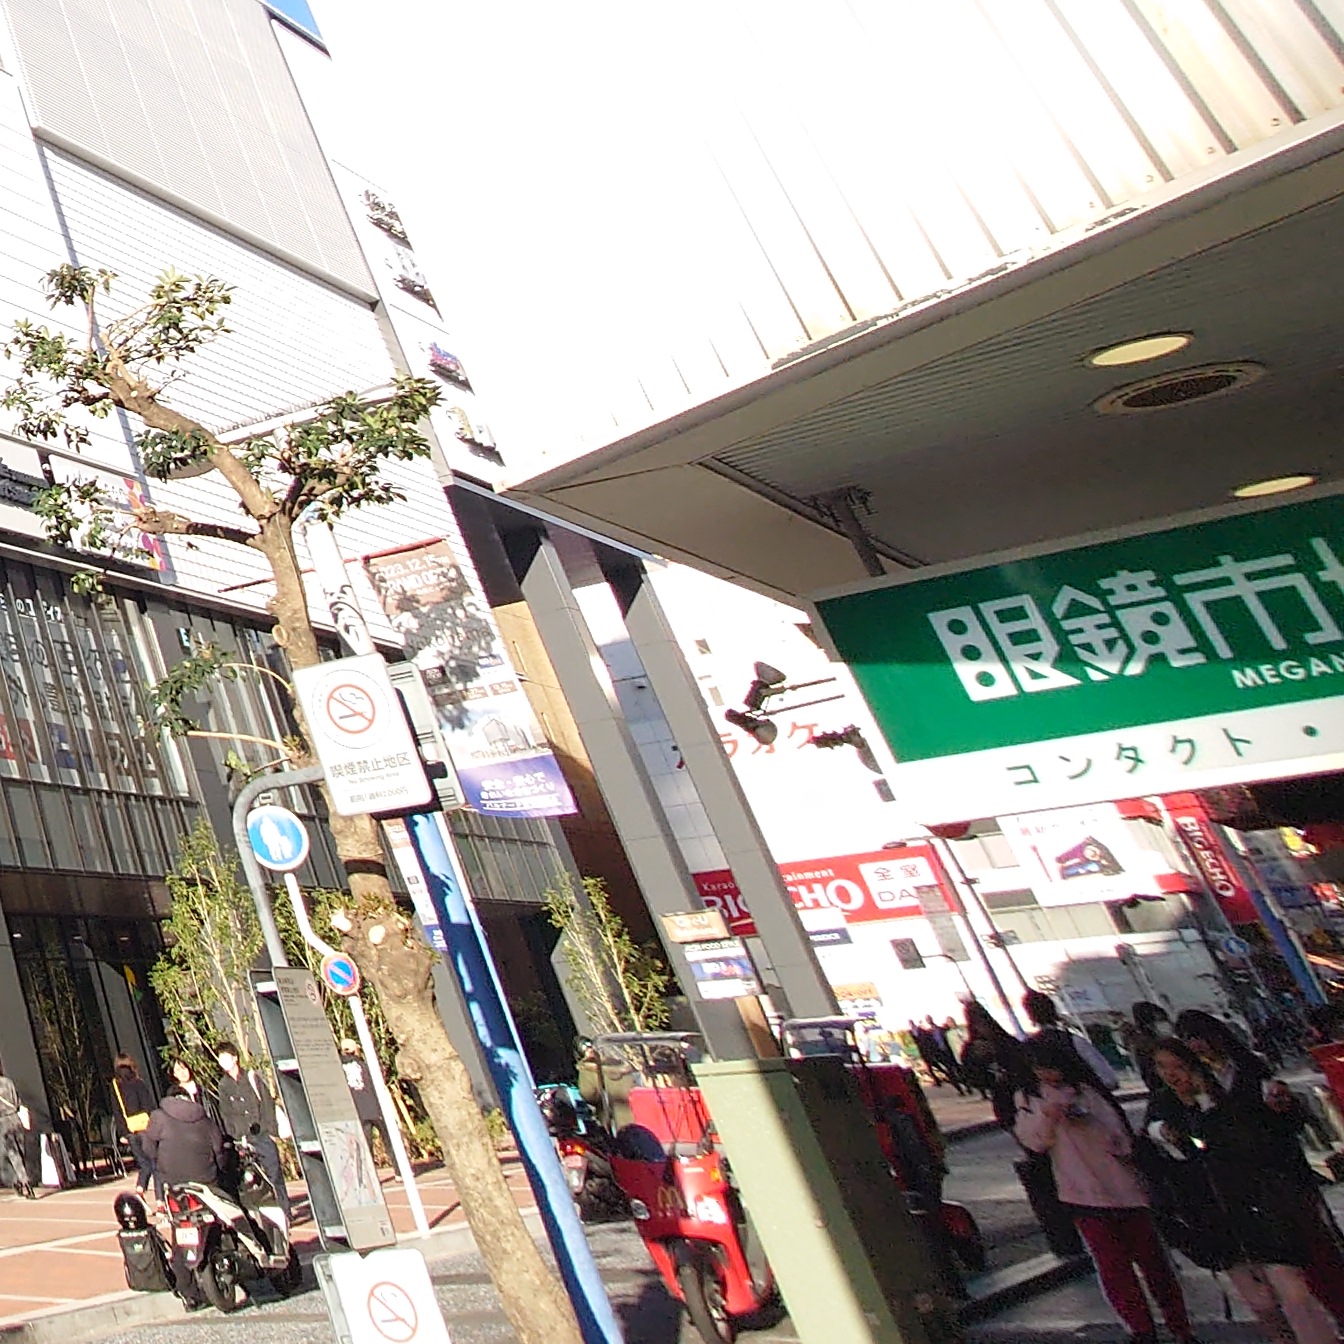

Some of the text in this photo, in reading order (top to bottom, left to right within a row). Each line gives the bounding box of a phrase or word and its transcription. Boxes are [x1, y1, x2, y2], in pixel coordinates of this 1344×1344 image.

[927, 531, 1344, 703] 眼鏡市
[1176, 816, 1235, 897] BIG ECHO
